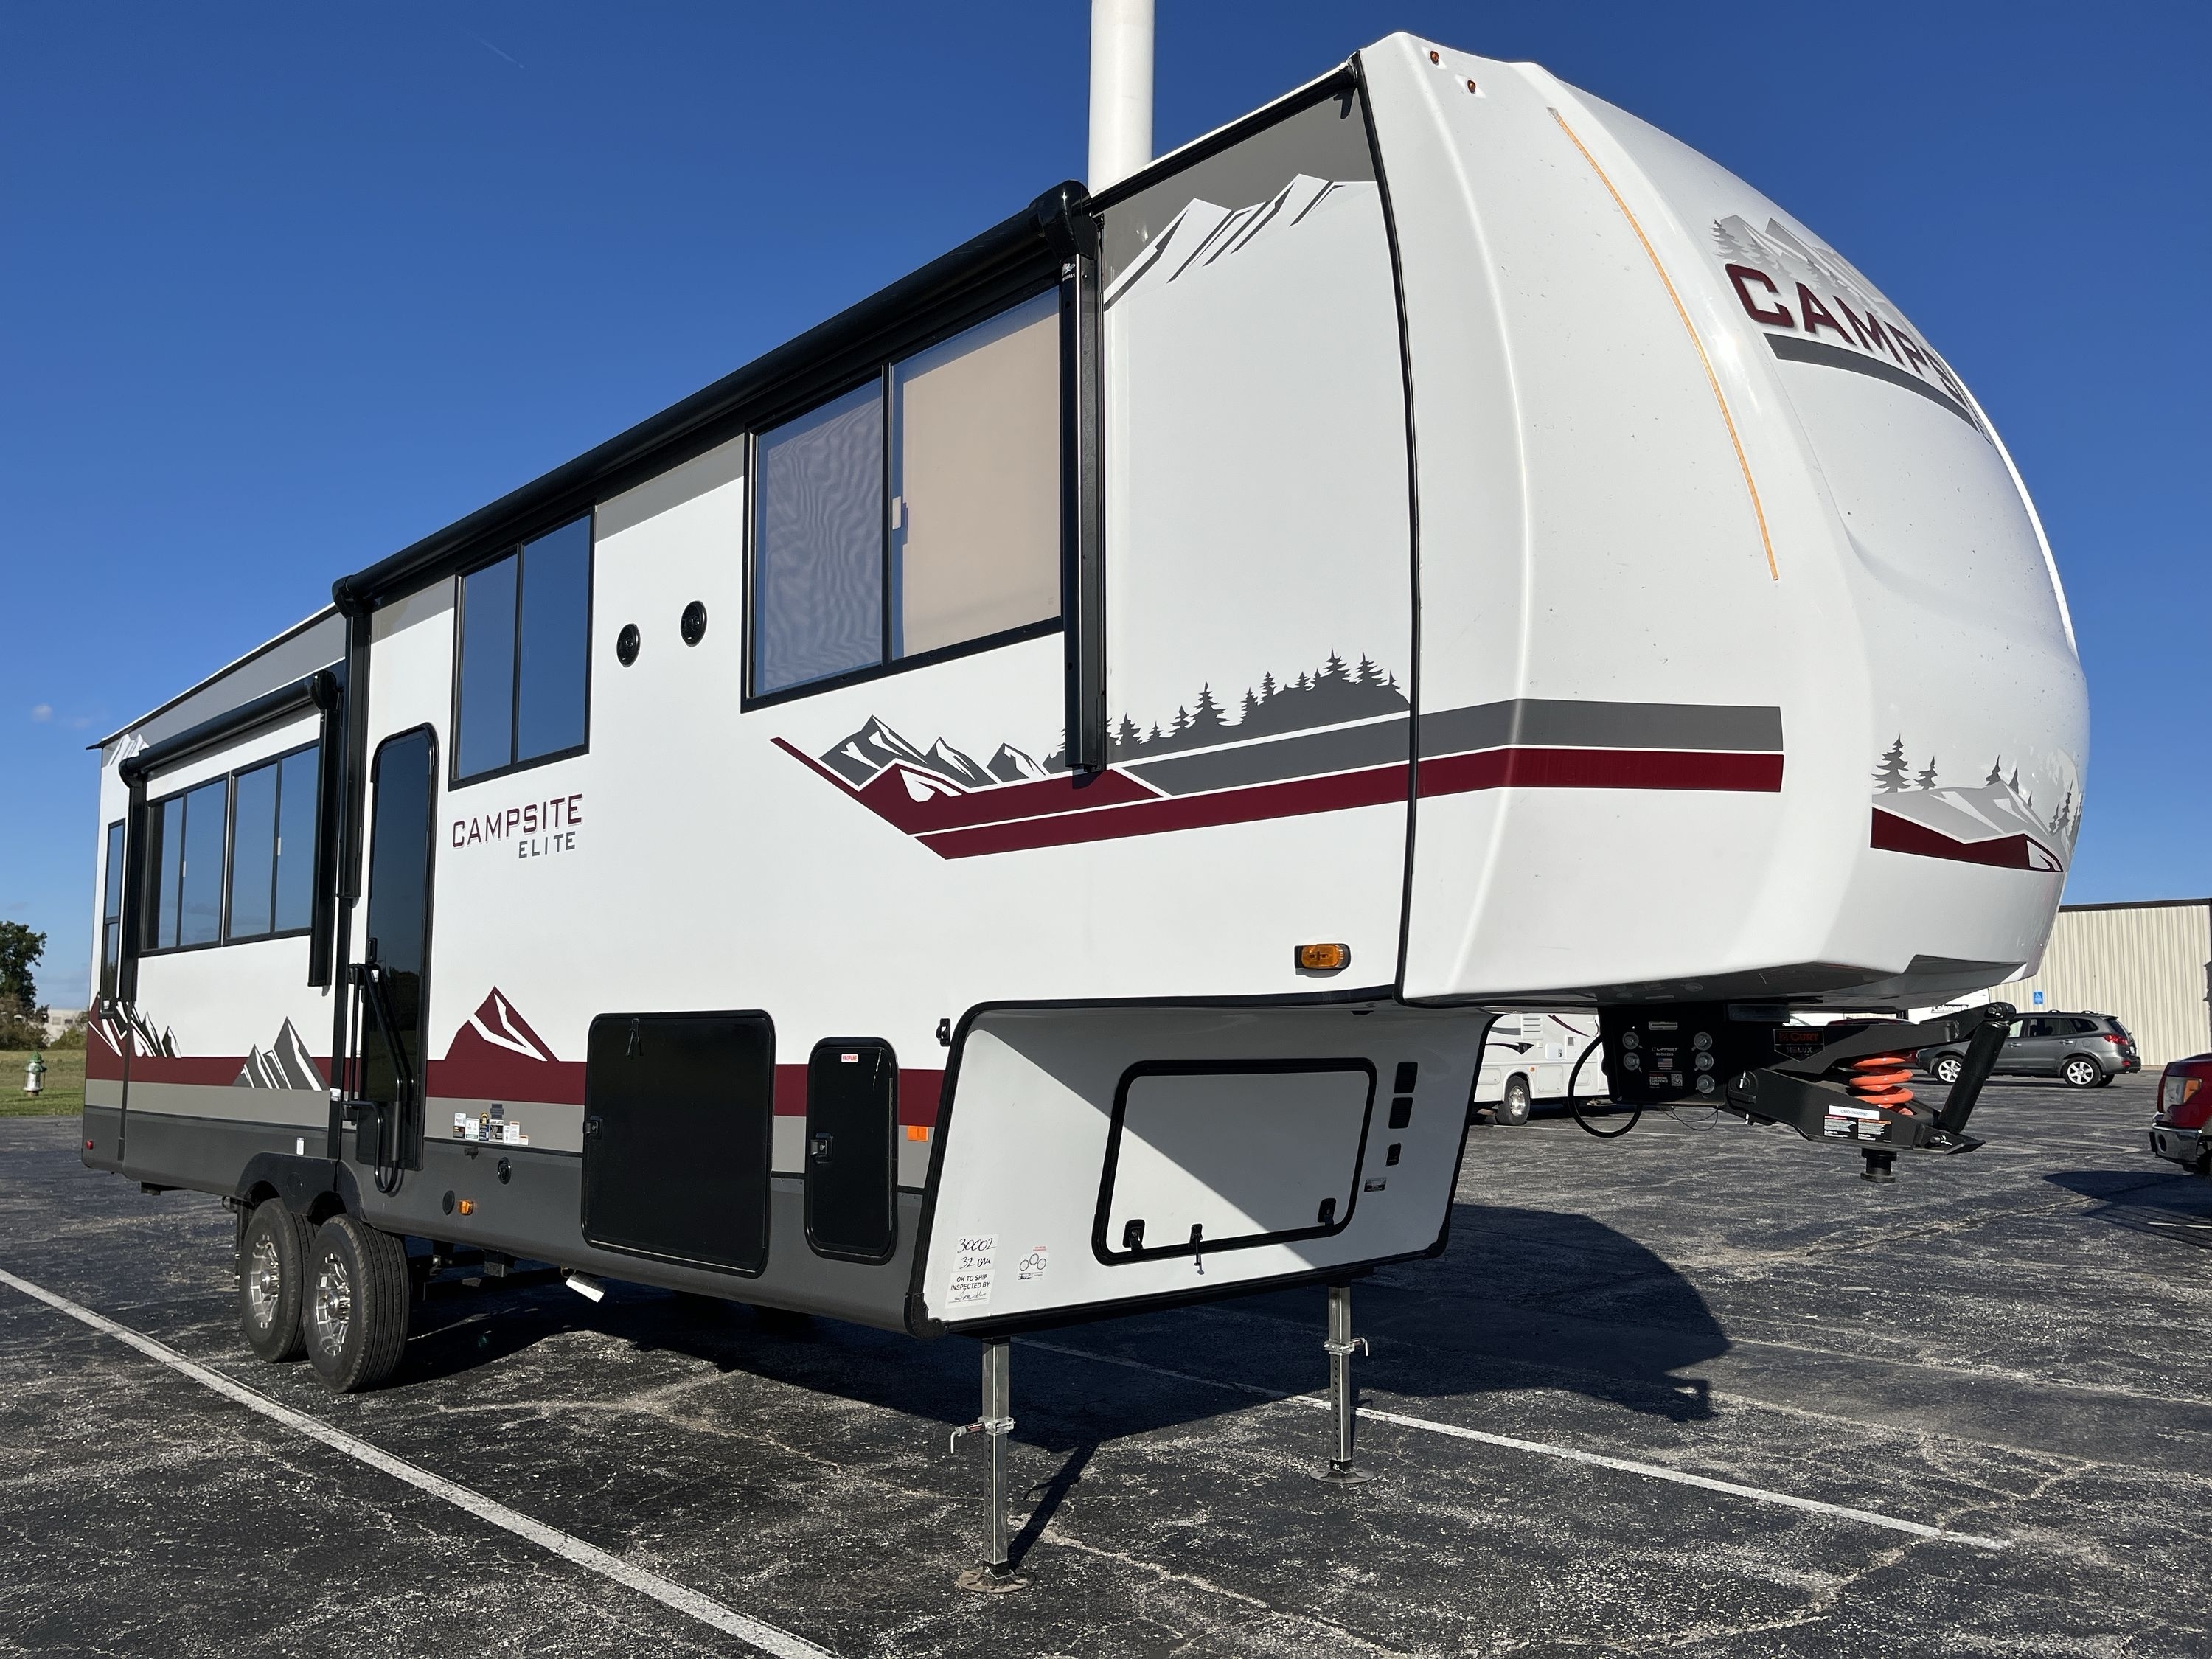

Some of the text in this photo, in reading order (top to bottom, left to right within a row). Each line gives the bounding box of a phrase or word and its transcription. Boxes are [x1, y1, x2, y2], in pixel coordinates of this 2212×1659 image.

[452, 793, 583, 849] CAMPSITE
[518, 831, 576, 859] ELITE
[957, 1238, 996, 1253] 30002
[959, 1256, 975, 1269] 32
[950, 1282, 981, 1291] INSPECTED
